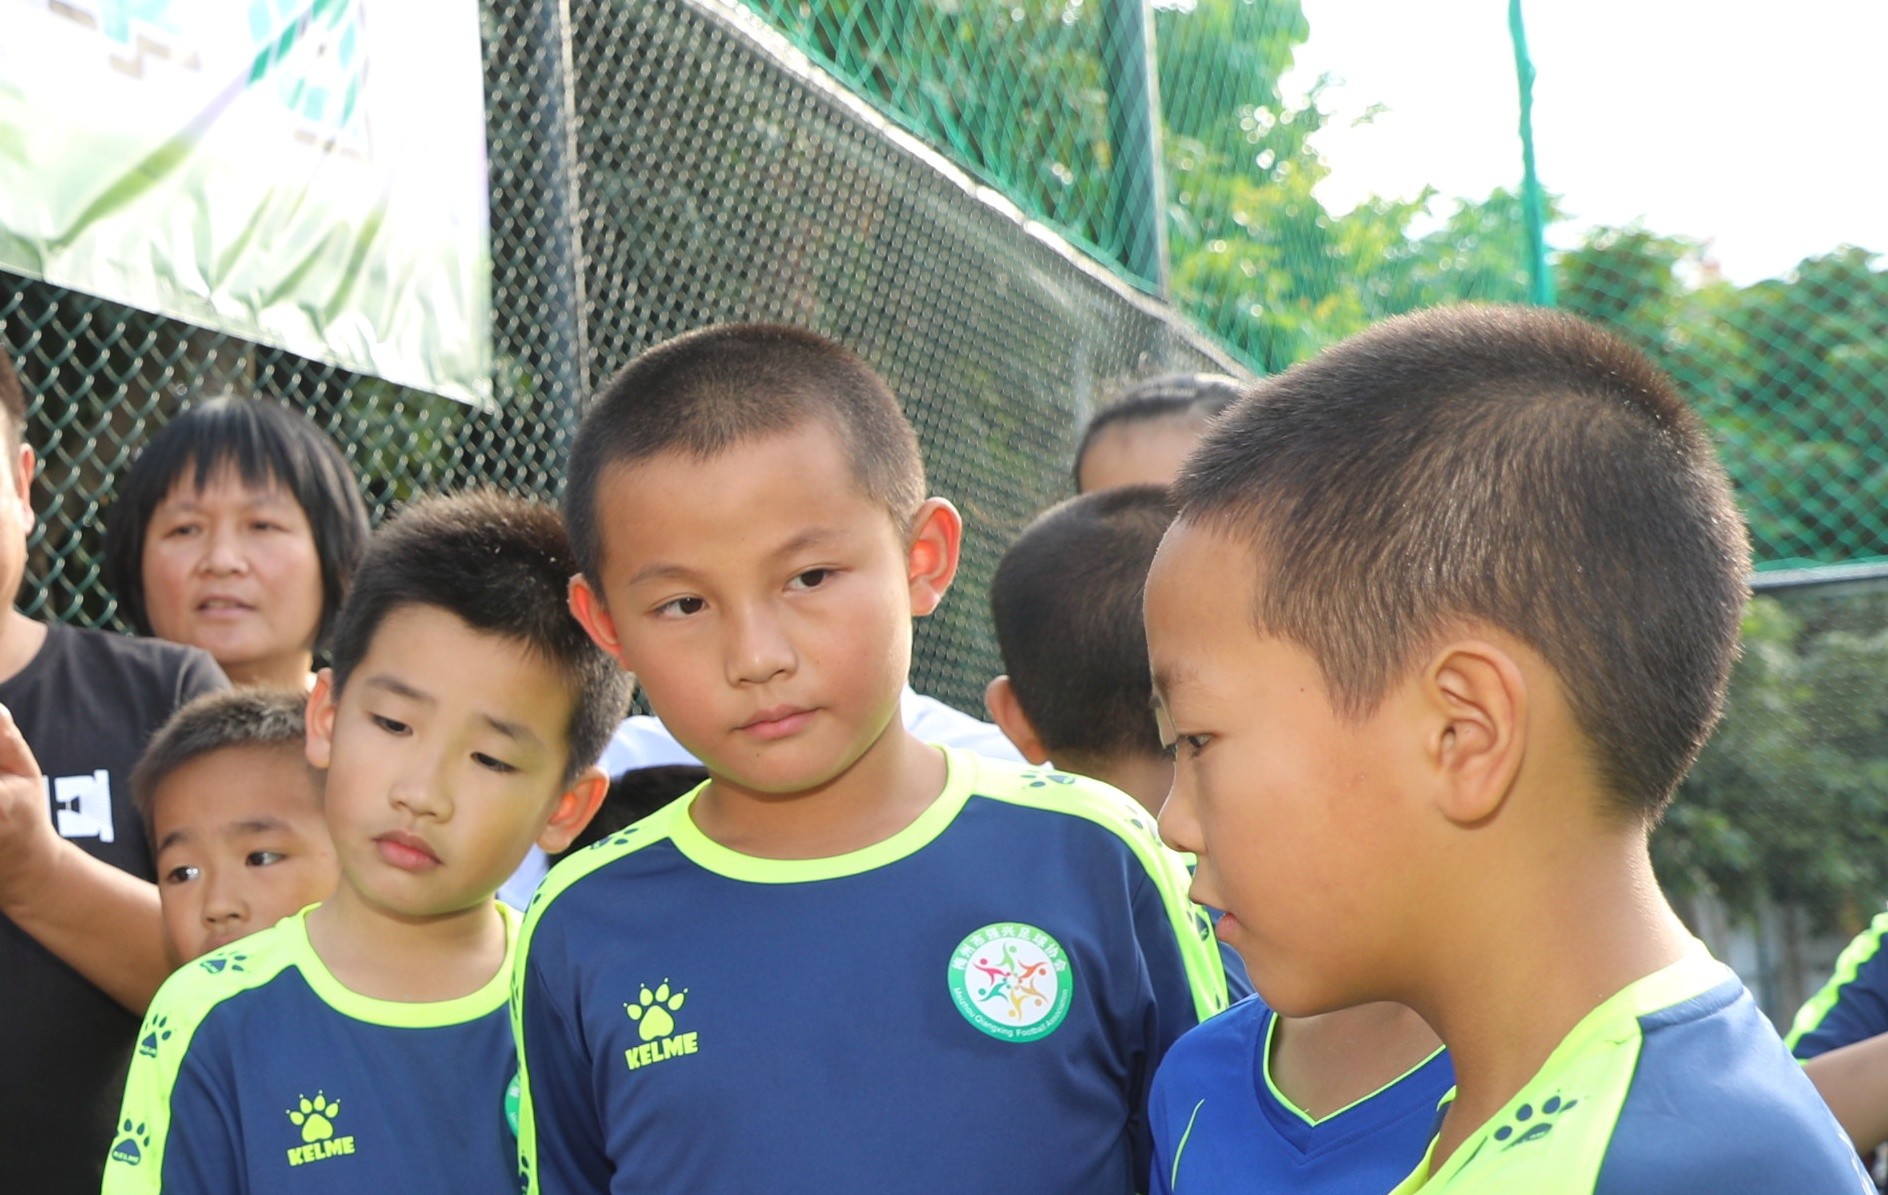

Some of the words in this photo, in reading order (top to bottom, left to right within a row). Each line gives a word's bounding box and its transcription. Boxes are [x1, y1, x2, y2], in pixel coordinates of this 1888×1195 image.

[1015, 1023, 1048, 1037] Football
[1046, 988, 1069, 1027] Association
[624, 1031, 699, 1071] KELME
[287, 1135, 356, 1167] KELME
